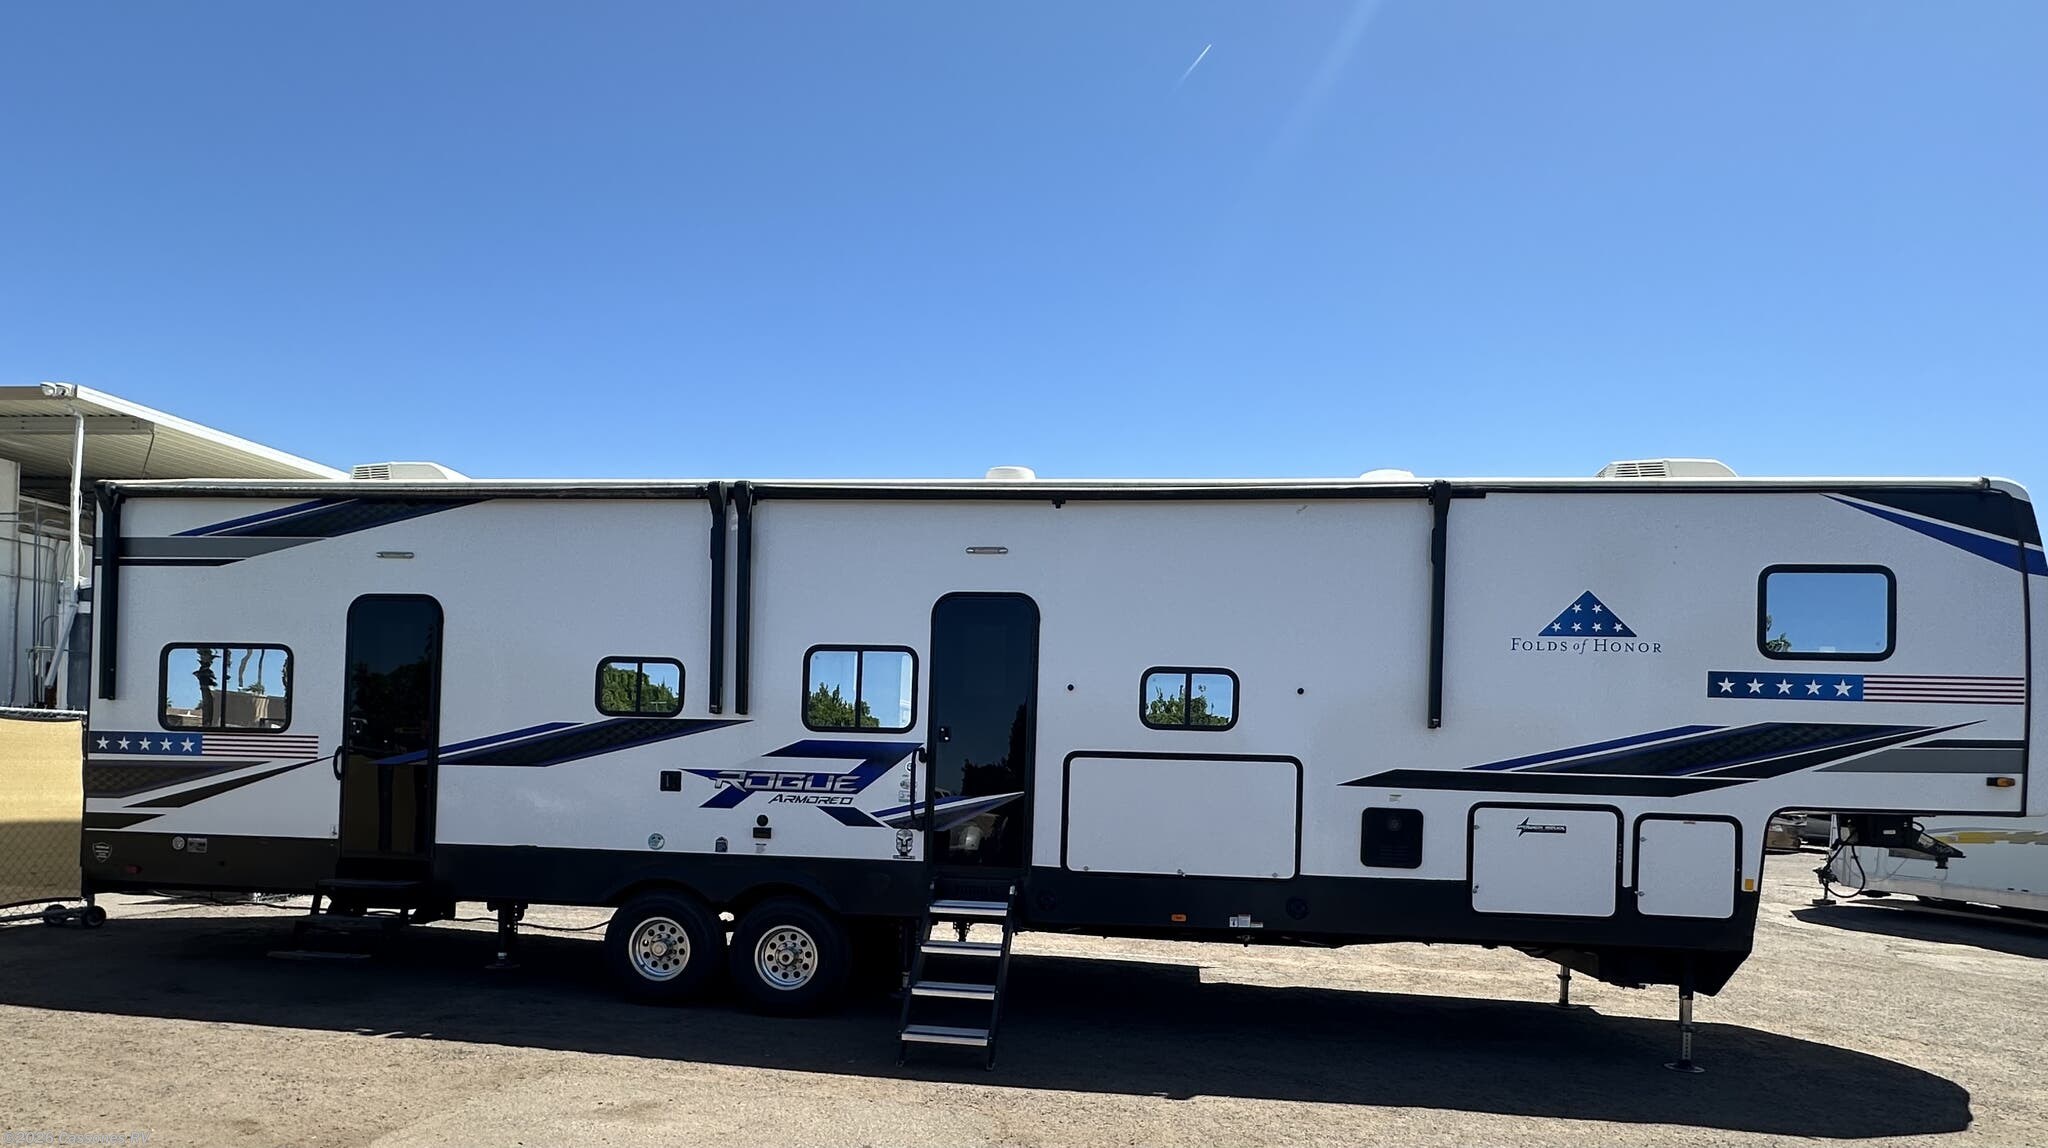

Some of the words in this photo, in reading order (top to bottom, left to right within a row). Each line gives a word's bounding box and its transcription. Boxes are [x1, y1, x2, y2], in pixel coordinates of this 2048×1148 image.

[1572, 638, 1589, 655] of
[711, 770, 861, 793] ROGUE
[768, 793, 854, 805] ARMORED
